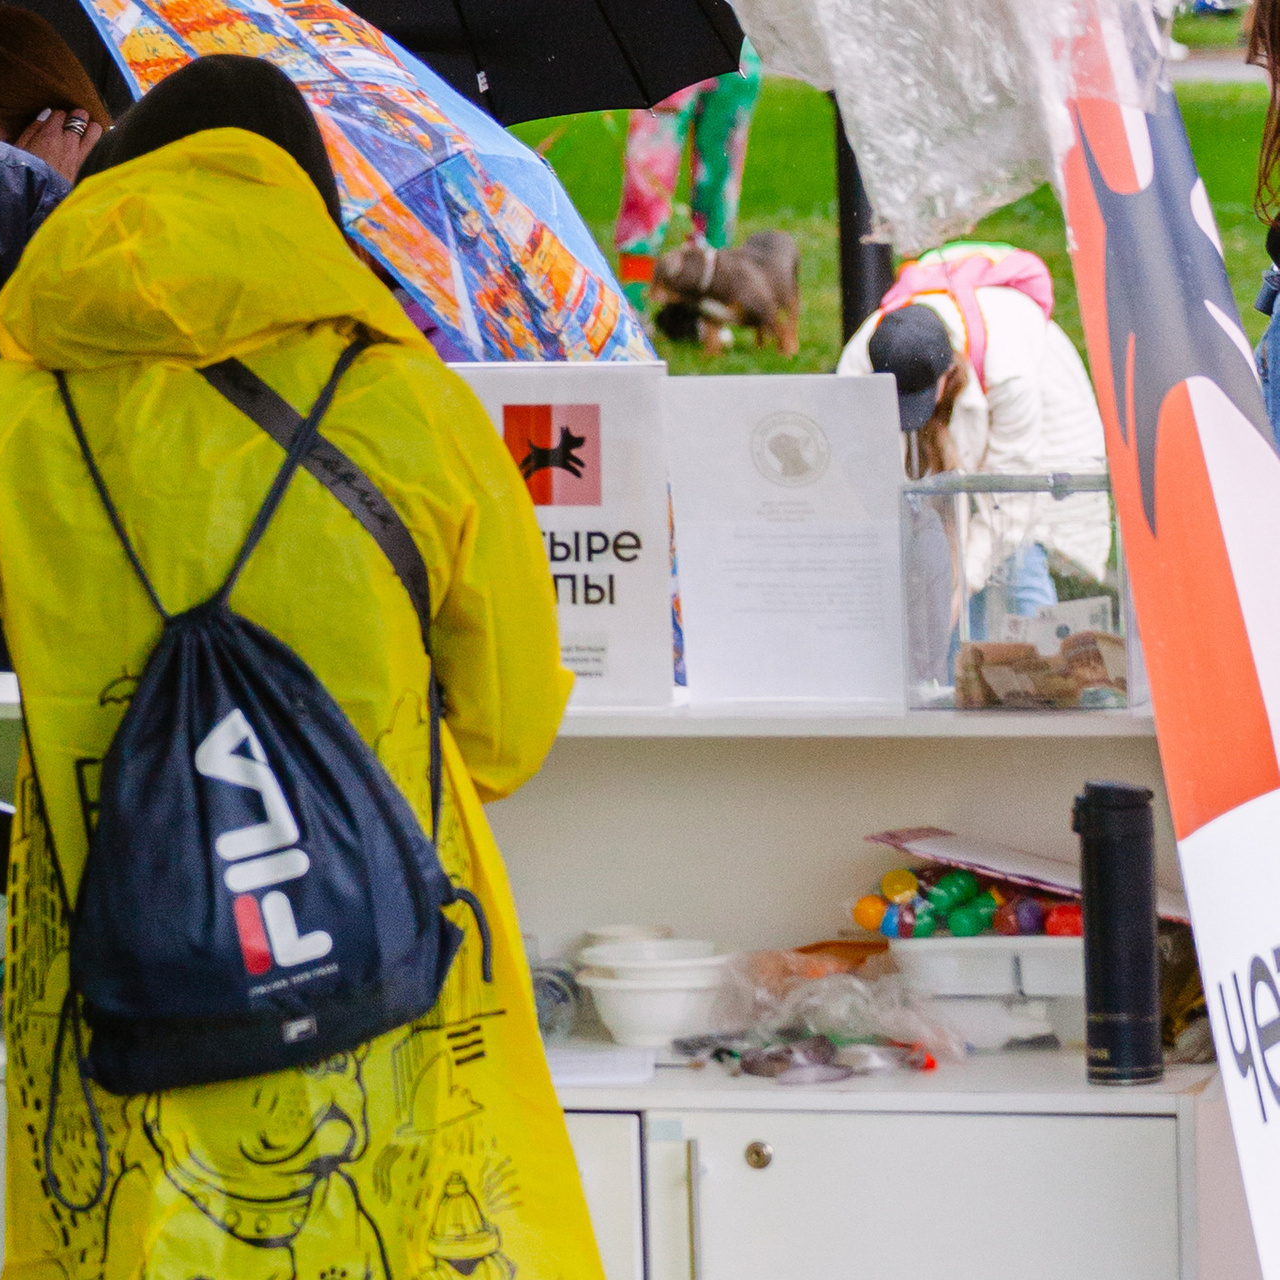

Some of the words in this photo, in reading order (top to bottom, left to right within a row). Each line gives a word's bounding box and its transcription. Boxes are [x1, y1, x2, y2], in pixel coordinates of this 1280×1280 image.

[542, 530, 642, 562] ыре
[194, 707, 333, 976] FILA
[1218, 946, 1280, 1123] че
